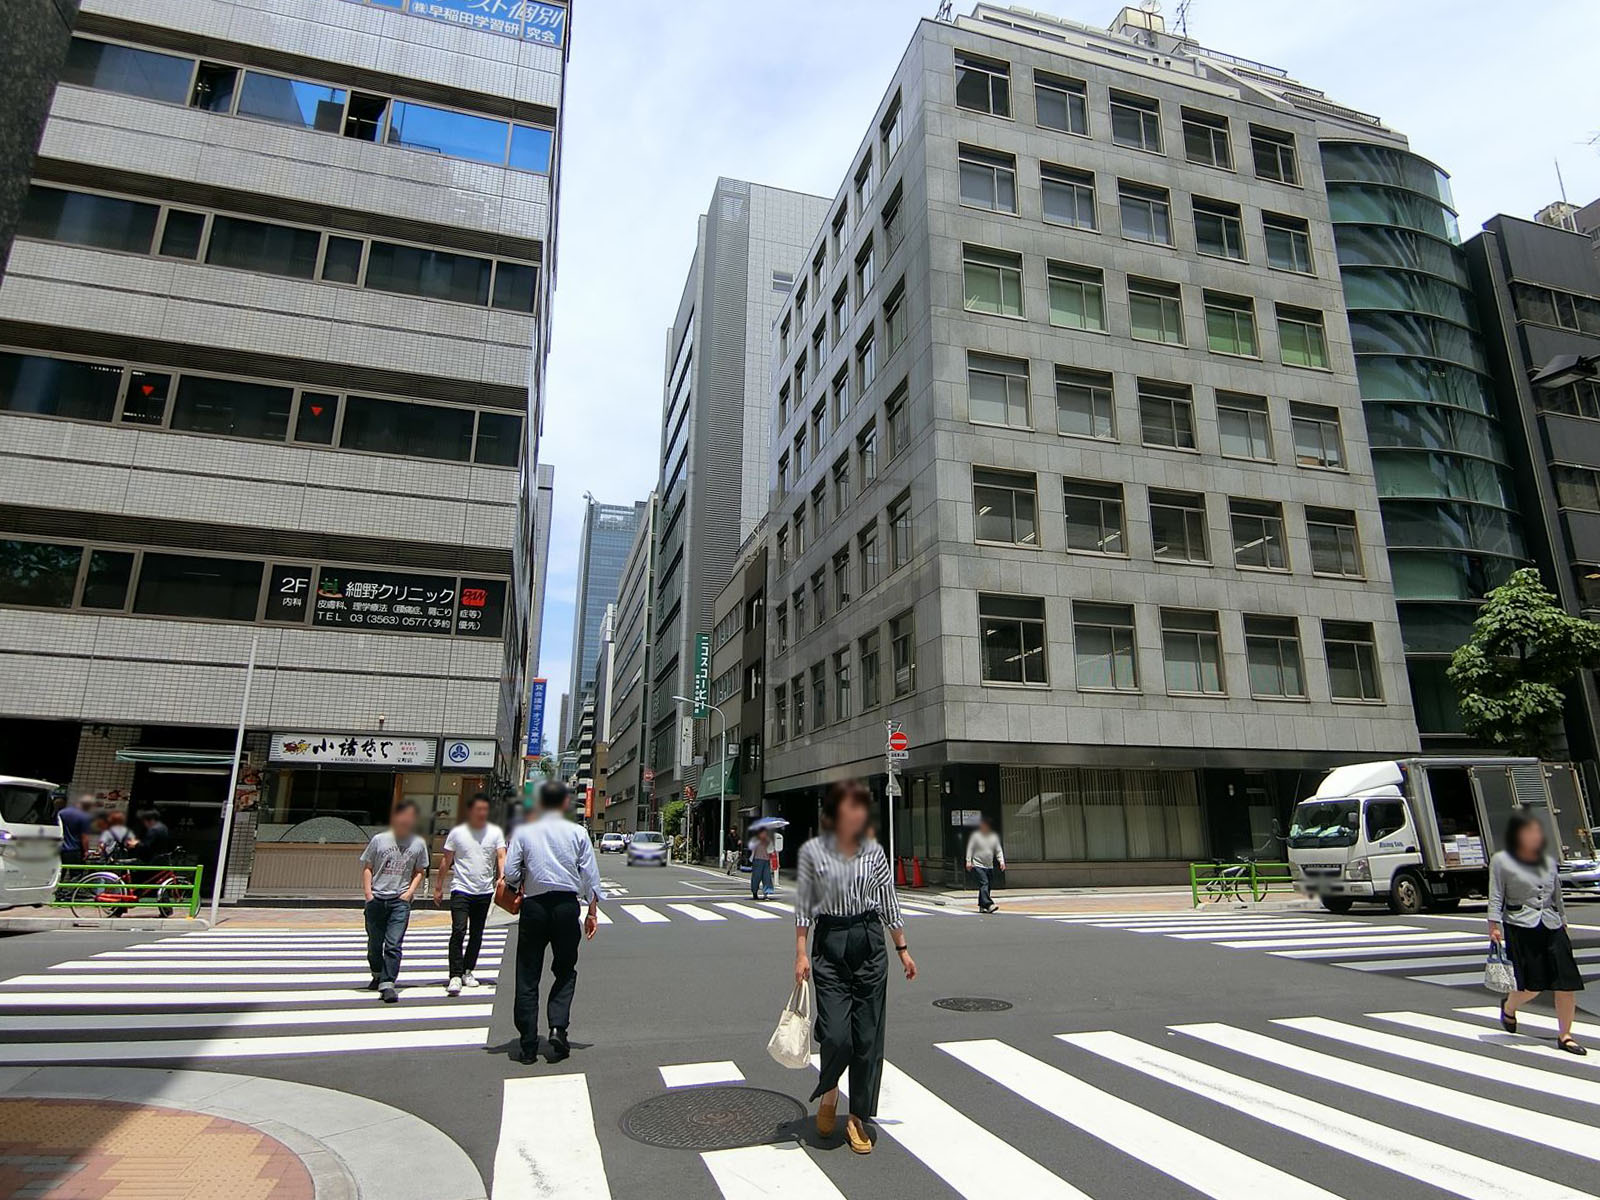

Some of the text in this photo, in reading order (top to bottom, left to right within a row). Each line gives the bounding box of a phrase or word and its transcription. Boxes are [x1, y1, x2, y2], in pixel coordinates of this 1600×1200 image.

[280, 577, 309, 593] 2F
[345, 581, 455, 604] 細野クリニック
[282, 597, 302, 607] 内科
[317, 611, 342, 621] TEL
